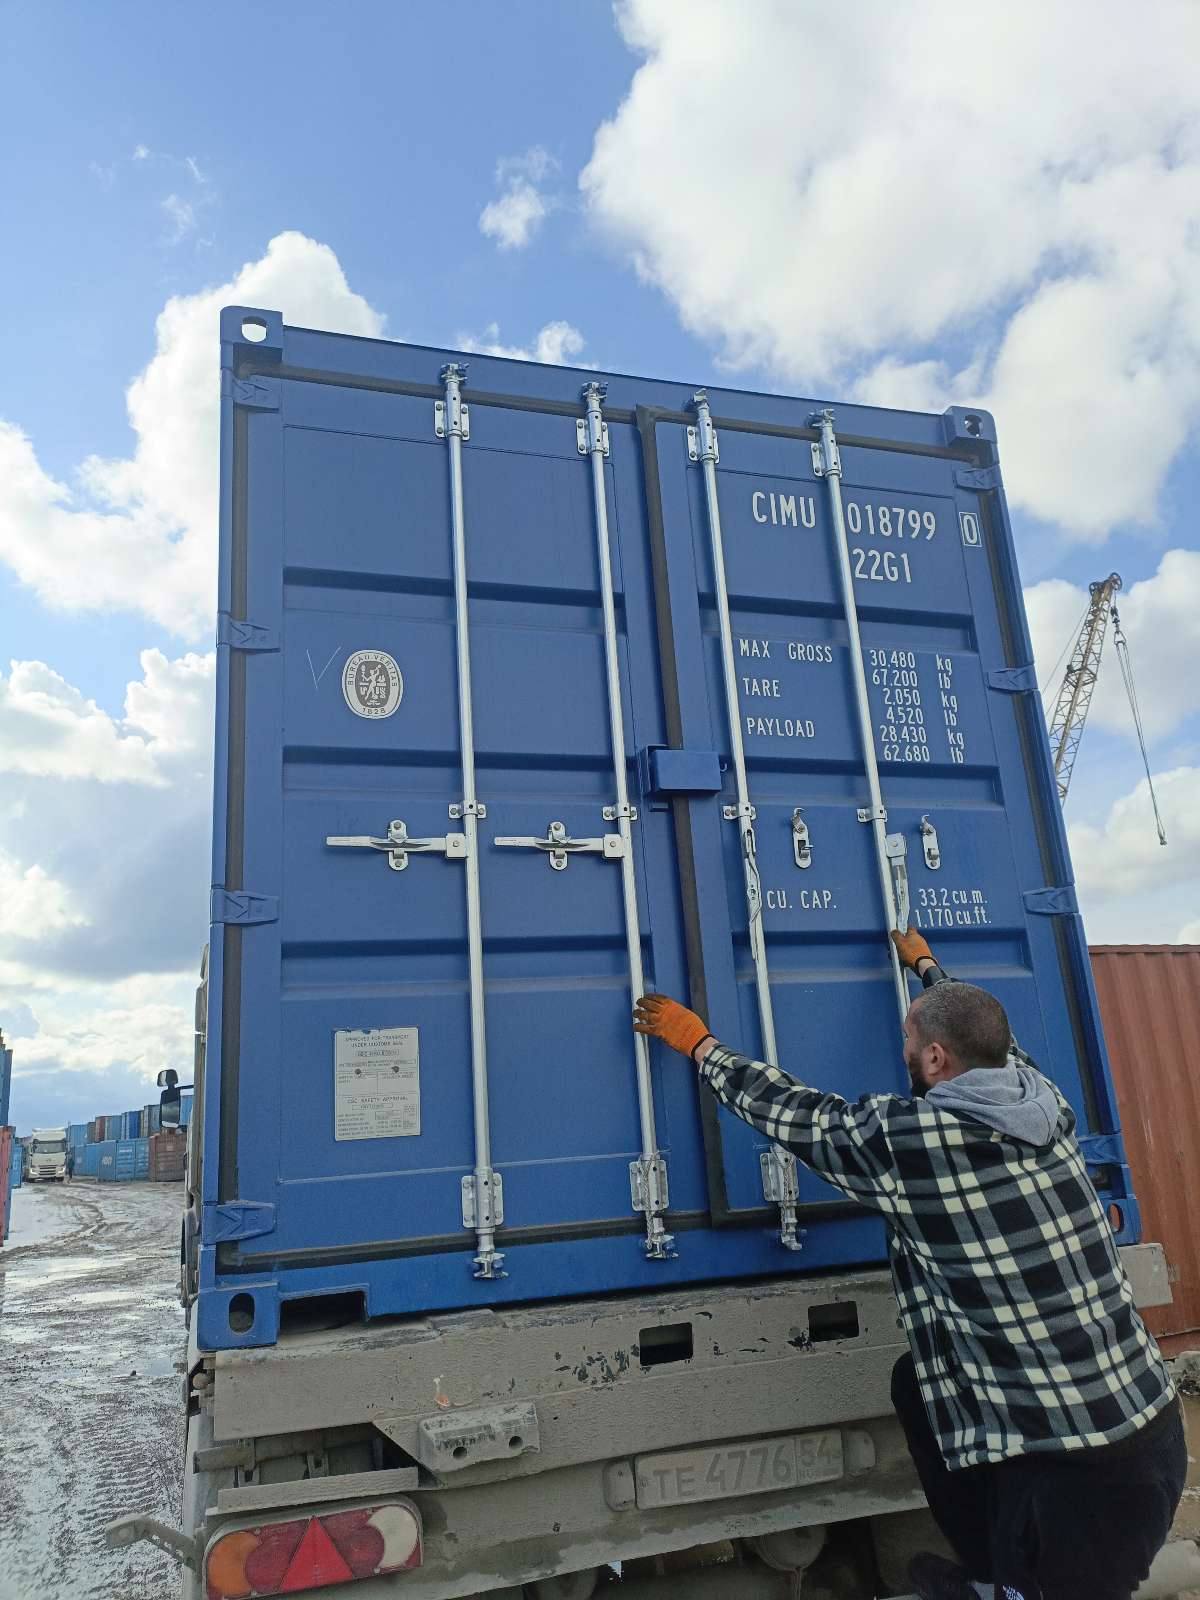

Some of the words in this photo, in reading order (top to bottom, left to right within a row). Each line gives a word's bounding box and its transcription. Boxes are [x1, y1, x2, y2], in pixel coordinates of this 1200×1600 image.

[752, 491, 816, 529] CIMU
[847, 502, 937, 541] 018799
[963, 514, 978, 545] 0
[852, 547, 913, 584] 22G1
[739, 638, 771, 659] MAX
[788, 642, 833, 663] GROSS
[935, 653, 953, 676] kg
[742, 677, 781, 698] TARE
[941, 690, 958, 713] kg
[938, 672, 951, 689] lb
[746, 717, 815, 738] PAYLOAD
[947, 728, 965, 750] kg
[944, 709, 957, 726] lb
[950, 746, 964, 764] lb
[766, 889, 794, 910] CU.
[800, 890, 838, 910] CAP.
[918, 887, 951, 907] 33.2
[652, 1465, 695, 1501] TE
[704, 1443, 793, 1492] 4776
